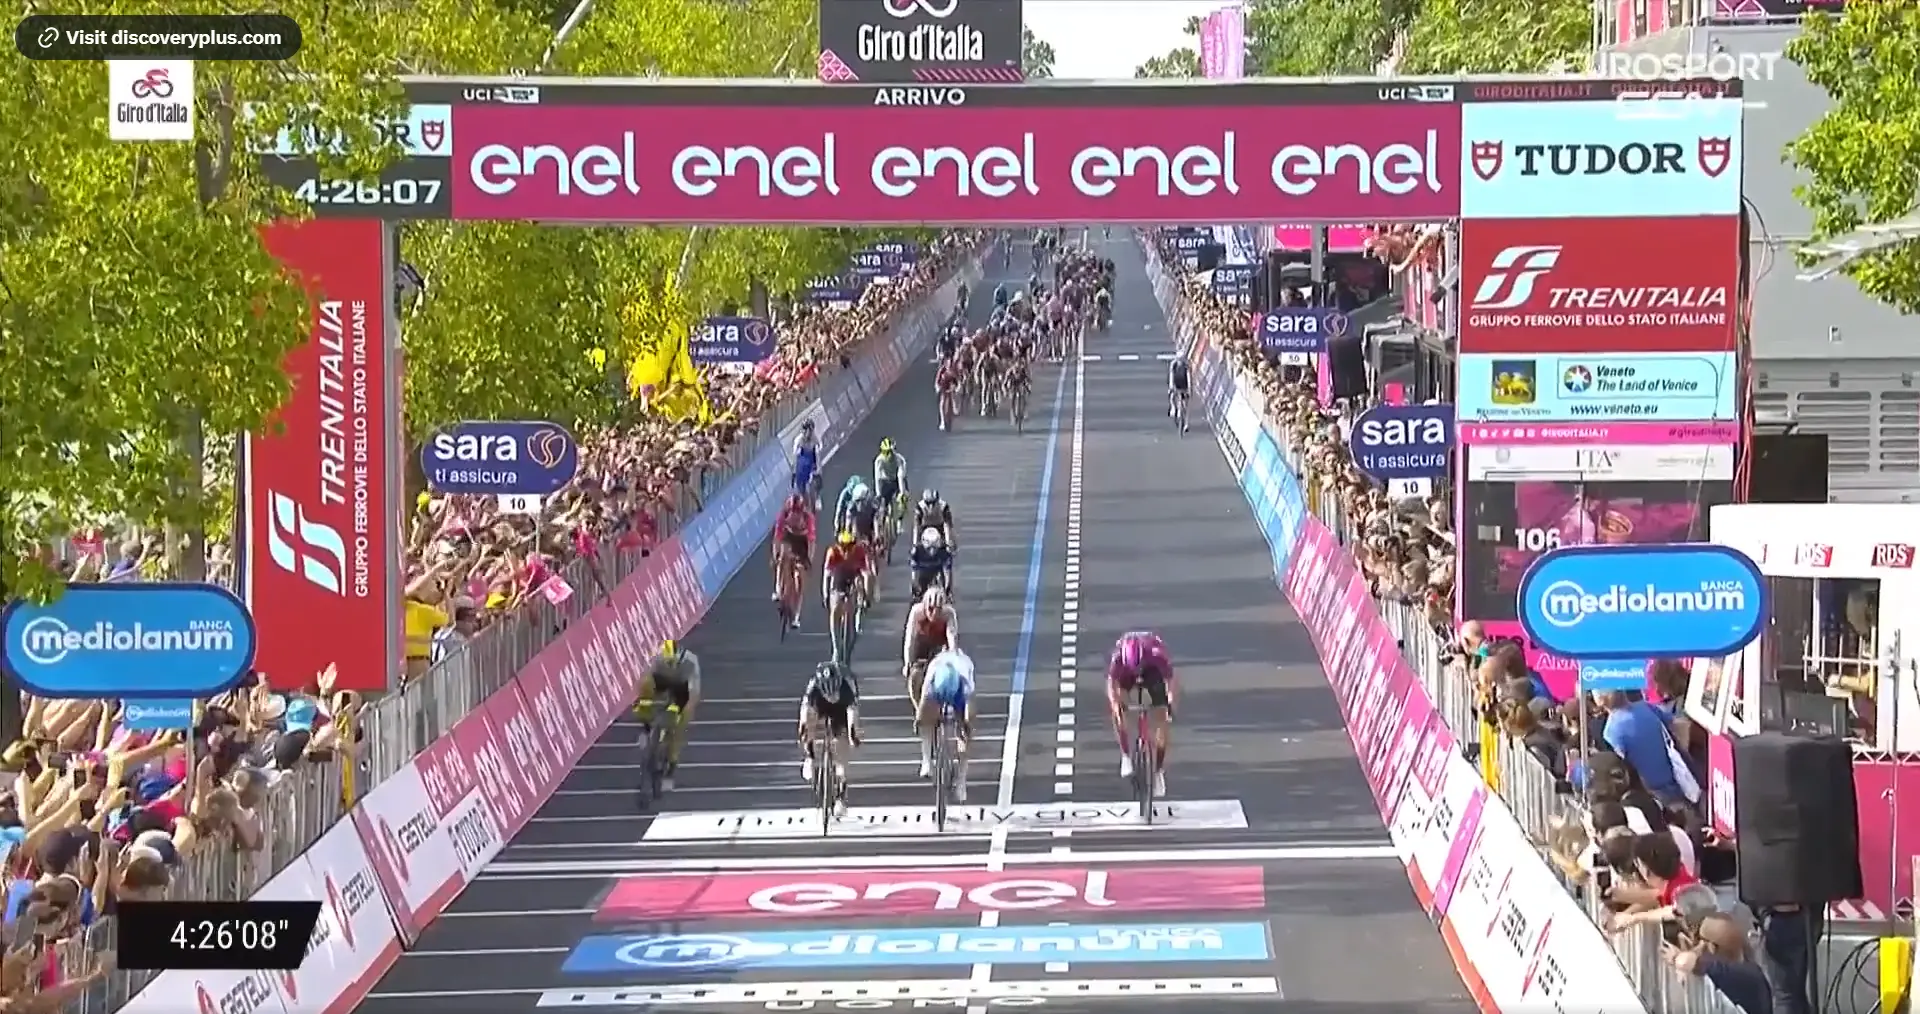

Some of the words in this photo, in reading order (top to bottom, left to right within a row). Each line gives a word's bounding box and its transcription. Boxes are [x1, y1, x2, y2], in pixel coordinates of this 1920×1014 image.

[857, 23, 906, 61] Giro
[908, 23, 984, 61] d'Italia
[463, 88, 491, 101] UCI
[874, 88, 966, 106] ARRIVO
[1378, 87, 1405, 100] UCI
[469, 131, 641, 197] enel
[671, 131, 840, 197] enel
[871, 131, 1040, 197] enel
[1070, 130, 1240, 197] enel
[1271, 129, 1442, 196] enel
[1514, 141, 1686, 177] TUDOR
[294, 178, 442, 205] 4:26:07
[1549, 286, 1726, 308] TRENITALIA
[352, 300, 366, 366] ITALIANE
[1266, 315, 1318, 334] sara
[1469, 314, 1522, 328] GRUPPO
[1524, 314, 1582, 327] FERROVIE
[1586, 313, 1625, 326] DELLO
[1628, 312, 1666, 326] STATO
[1669, 312, 1726, 325] ITALIANE
[1596, 365, 1636, 377] Veneto
[1596, 379, 1616, 391] The
[1618, 379, 1645, 391] Land
[1647, 379, 1660, 391] of
[1661, 379, 1699, 391] Venice
[319, 299, 345, 507] TRENITALIA
[353, 368, 367, 414] STATO
[1570, 403, 1659, 416] www.veneto.eu
[353, 415, 367, 462] DELLO
[1361, 417, 1446, 446] sara
[434, 432, 518, 462] sara
[1363, 453, 1375, 470] ti
[1378, 452, 1446, 469] assicura
[435, 469, 446, 484] ti
[450, 468, 518, 485] assicura
[1403, 481, 1419, 495] 10
[353, 463, 368, 536] FERROVIE
[509, 498, 526, 511] 10
[354, 537, 369, 599] GRUPPO
[1876, 544, 1908, 566] RDS
[1545, 583, 1745, 615] mediolanum
[1701, 581, 1744, 592] BANCA
[26, 620, 233, 656] mediolanum
[190, 620, 233, 631] BANCA
[747, 870, 1118, 913] enel
[628, 930, 1224, 961] mediolanum
